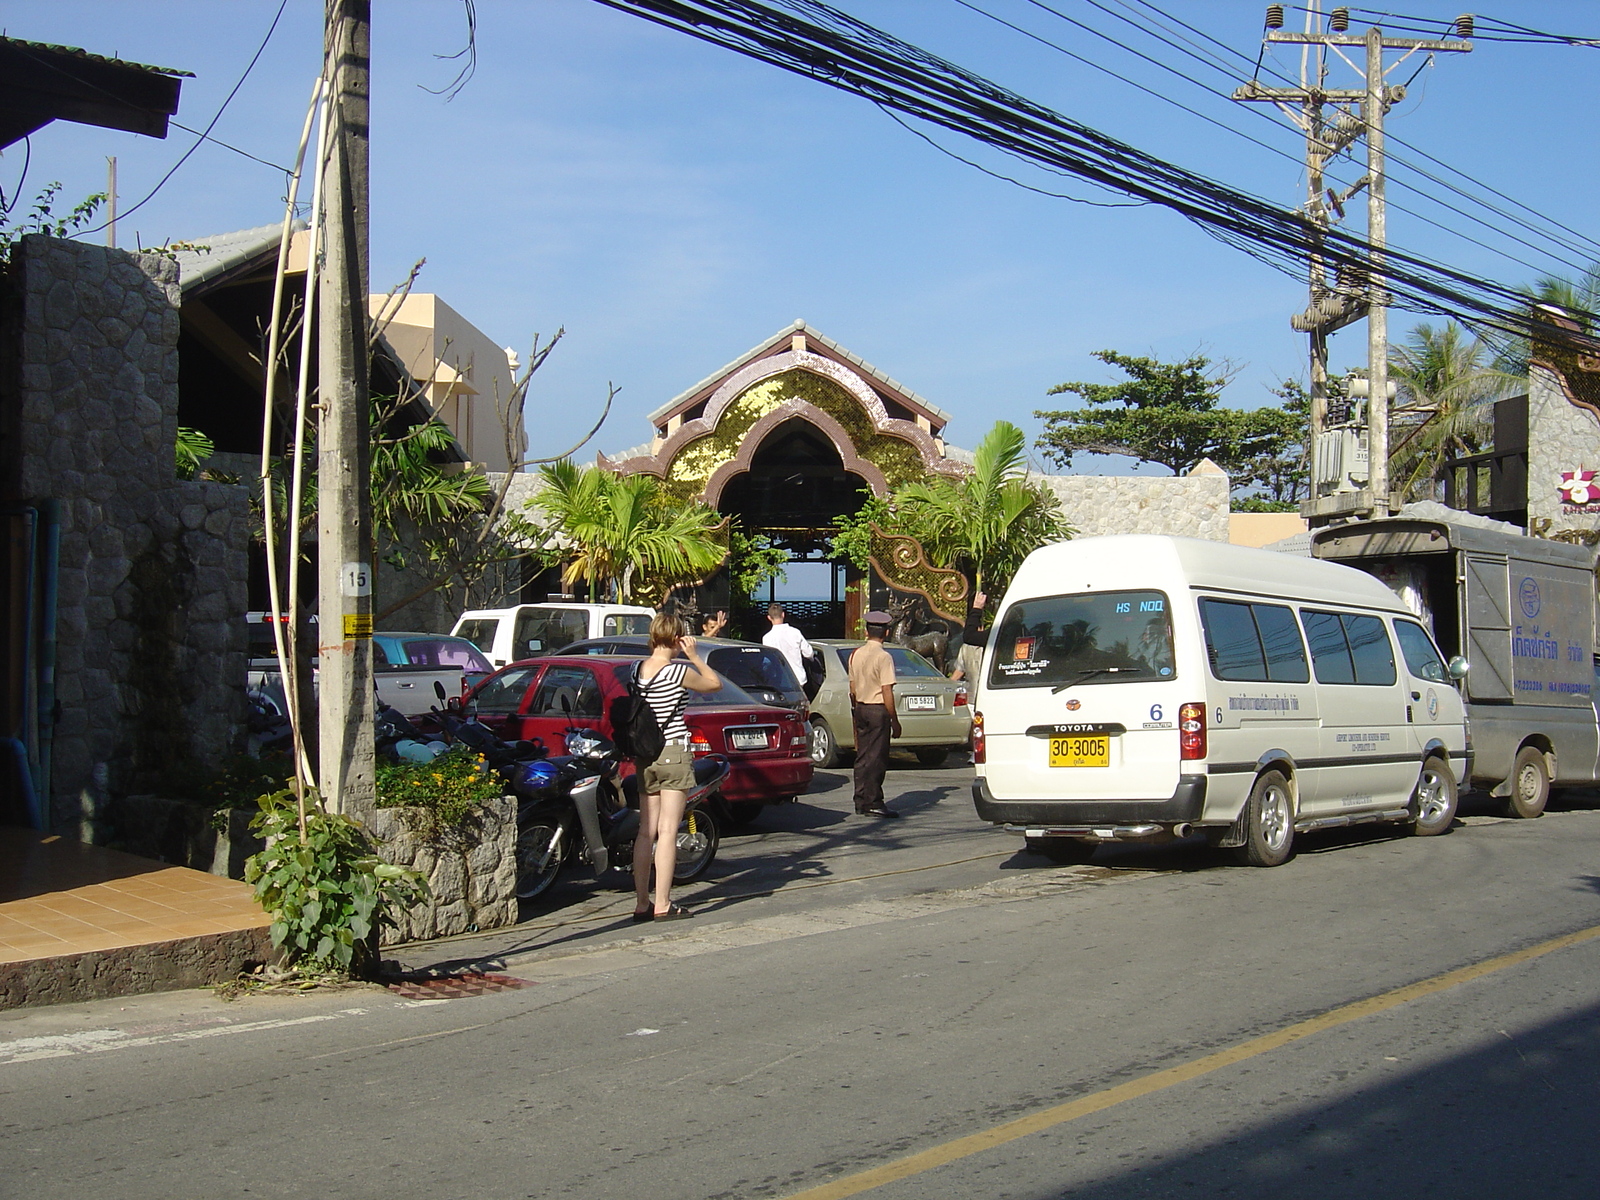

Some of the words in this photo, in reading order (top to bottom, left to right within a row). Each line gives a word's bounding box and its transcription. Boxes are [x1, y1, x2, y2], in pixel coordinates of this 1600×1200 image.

[349, 571, 366, 587] 15
[1116, 602, 1131, 613] HS
[1150, 703, 1163, 721] 6
[1215, 706, 1223, 724] 6
[1054, 724, 1094, 732] TOYOTA
[1052, 739, 1105, 756] 30-3005
